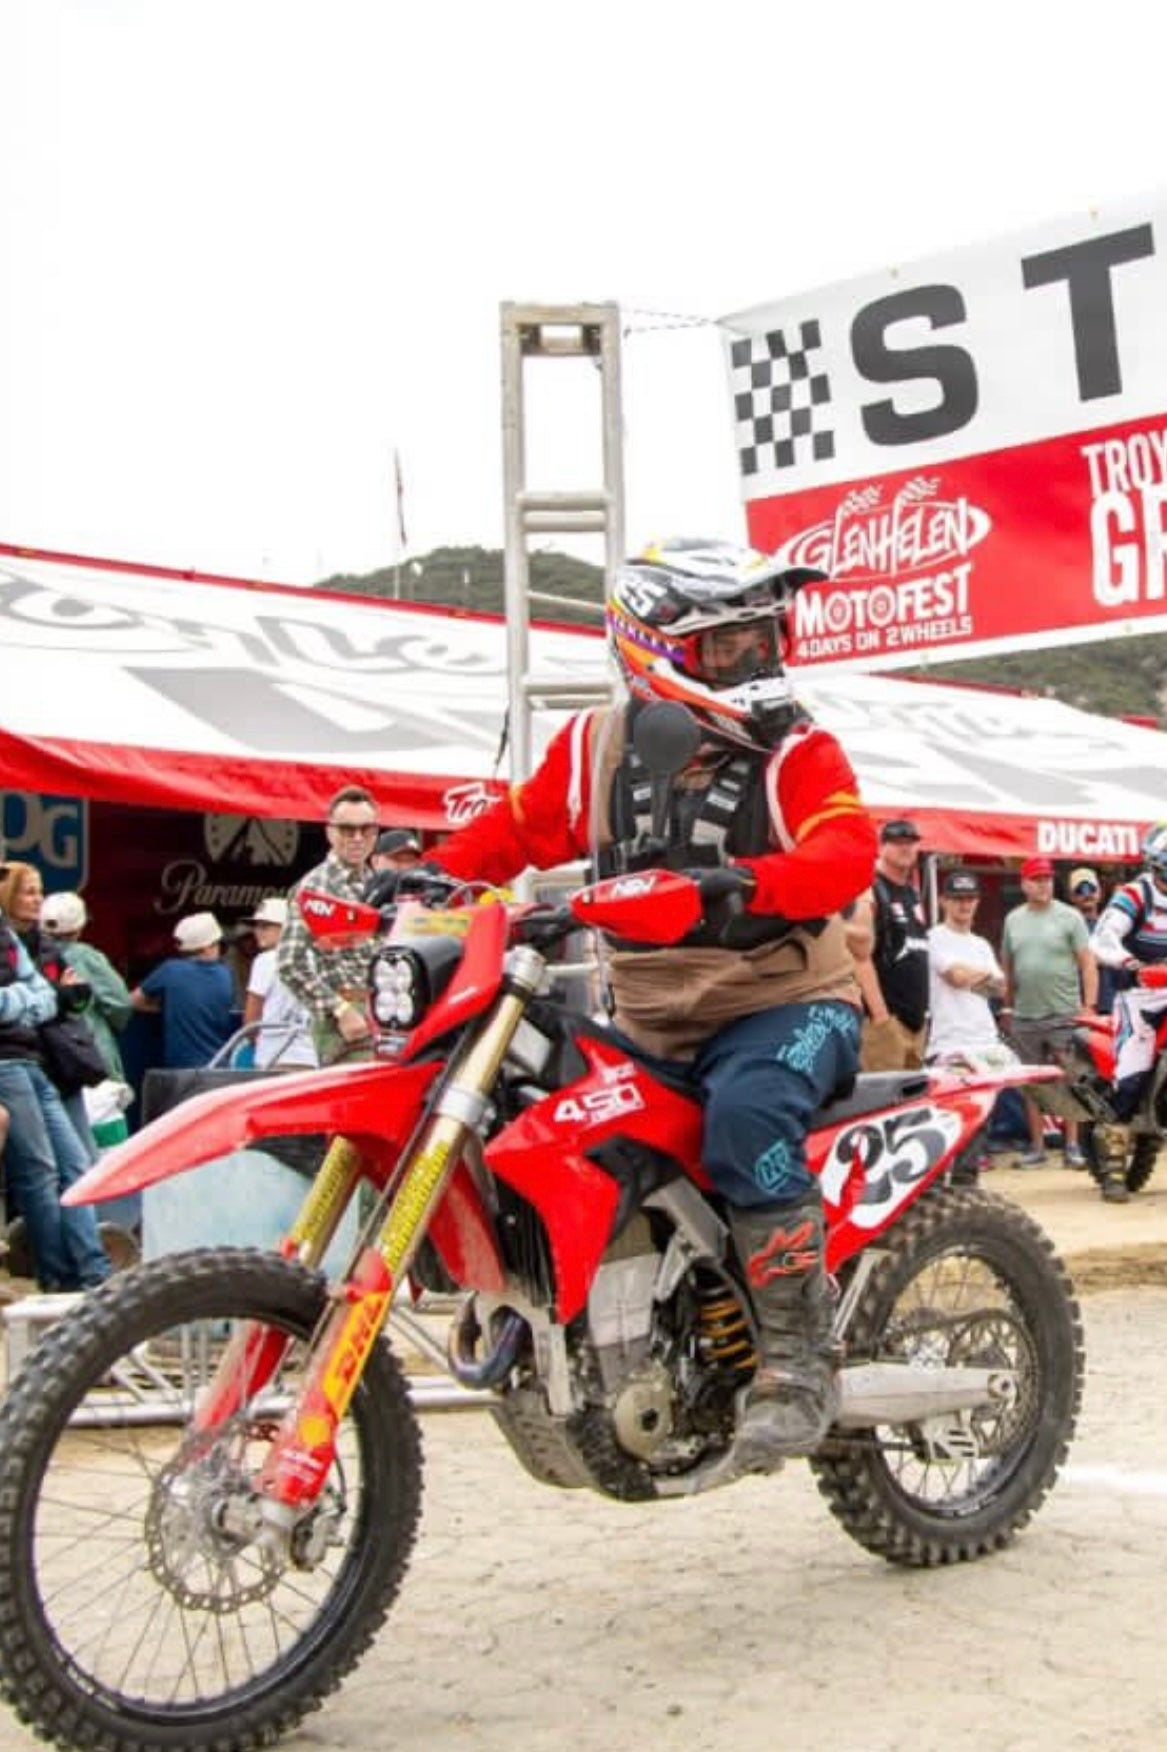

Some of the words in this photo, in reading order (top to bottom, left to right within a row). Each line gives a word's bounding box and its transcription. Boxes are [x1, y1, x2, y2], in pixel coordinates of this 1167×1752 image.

[795, 561, 973, 637] MOTOFEST
[444, 782, 500, 824] Tro
[1037, 820, 1139, 855] DUCATI
[153, 859, 297, 915] Paramo
[553, 1082, 645, 1123] 450
[836, 1106, 947, 1205] 25
